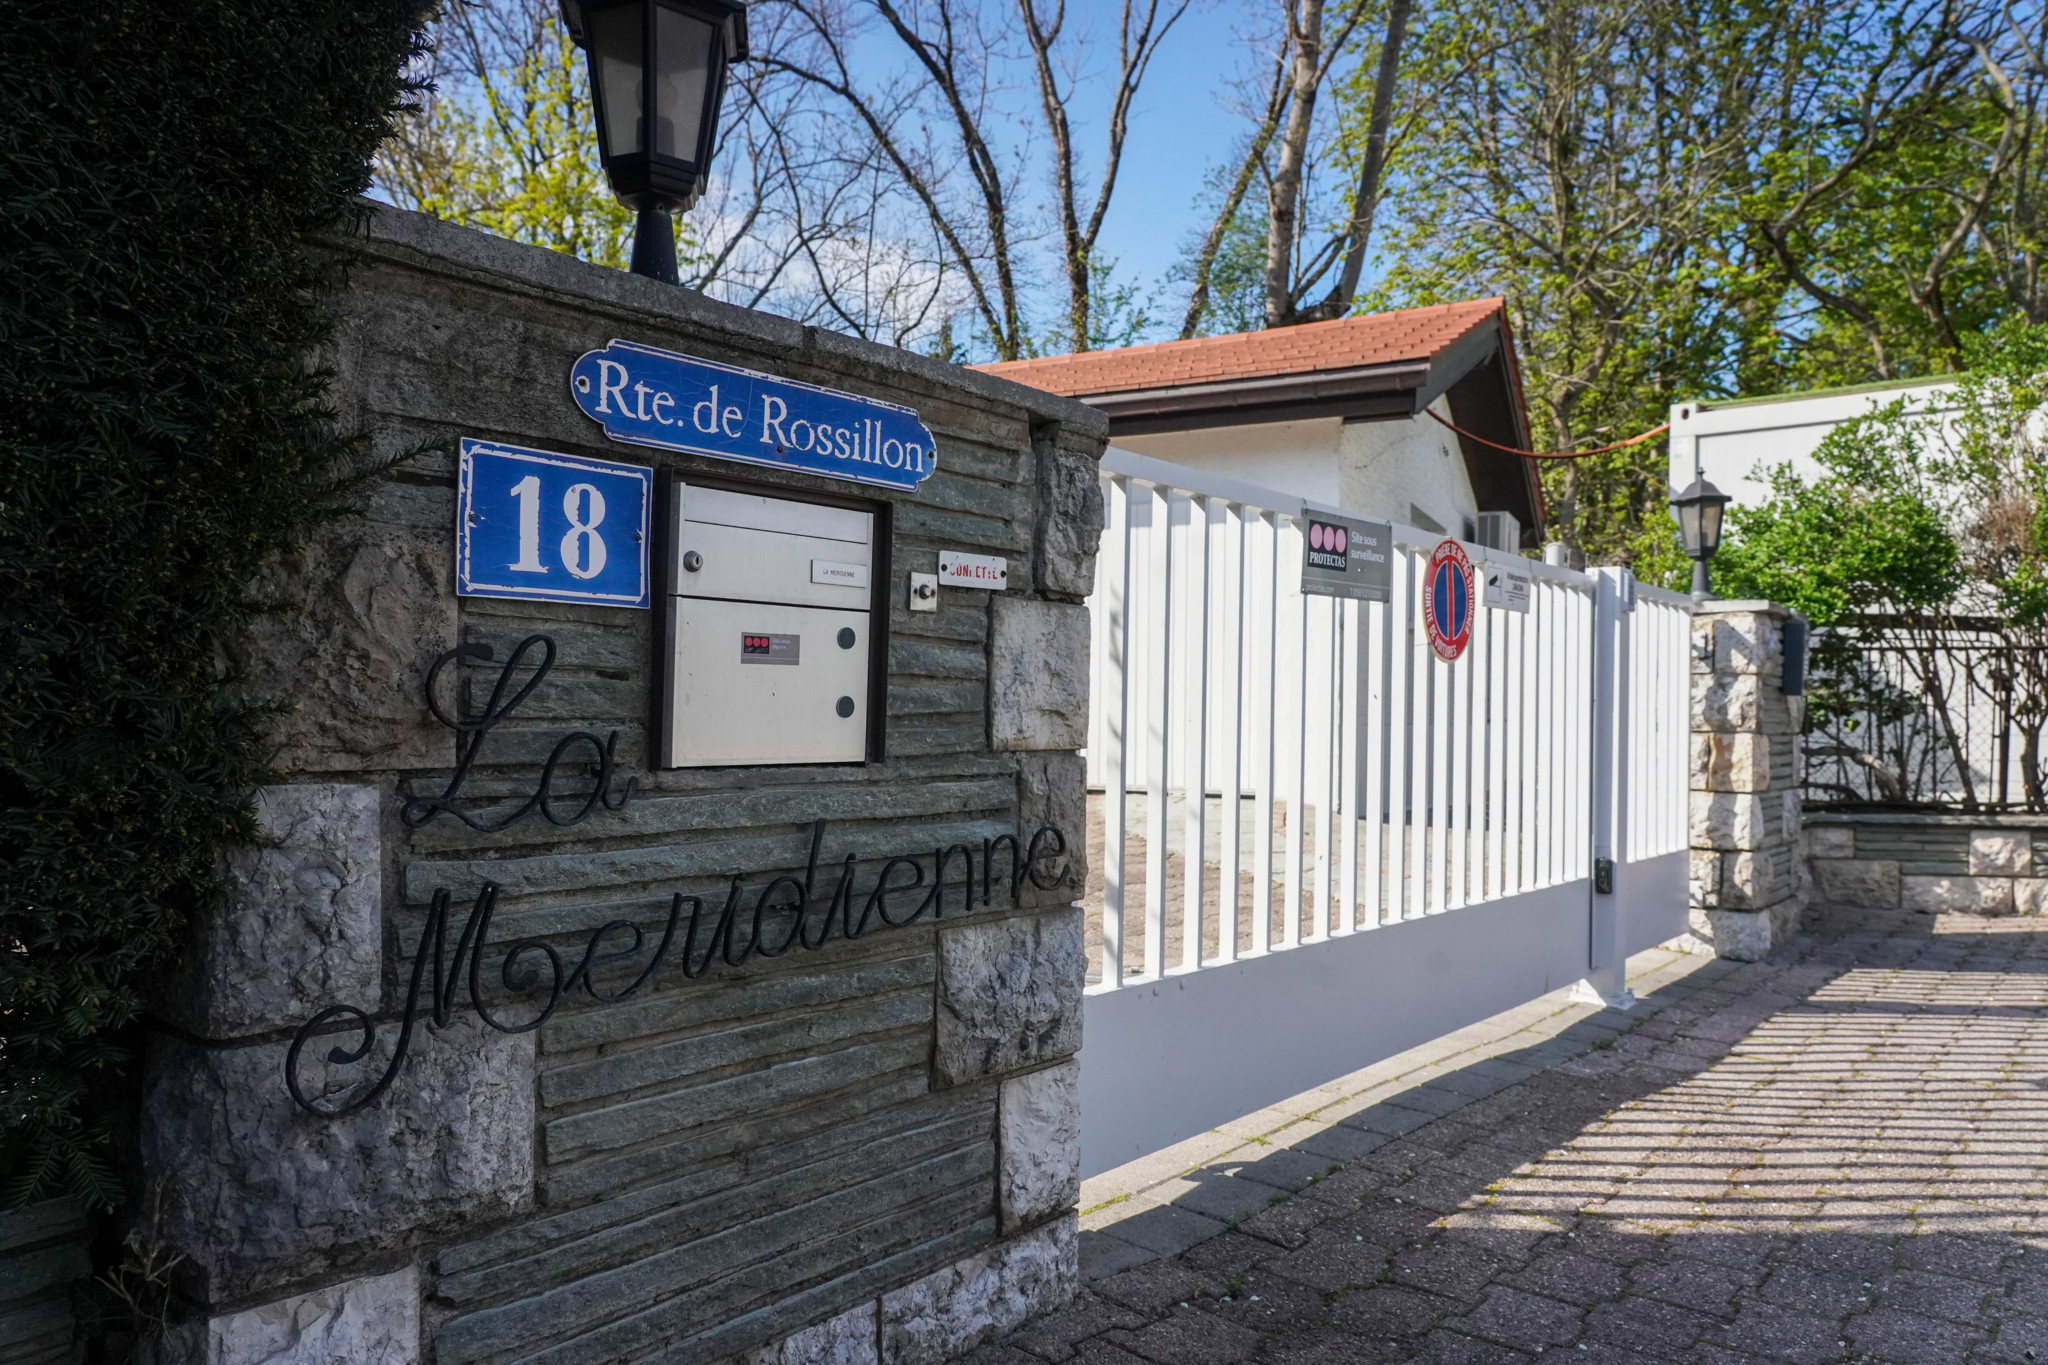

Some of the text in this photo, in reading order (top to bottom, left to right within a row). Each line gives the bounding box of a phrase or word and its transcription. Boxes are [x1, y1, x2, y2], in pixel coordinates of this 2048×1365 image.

[594, 358, 924, 474] Rte. de Rossillon
[506, 475, 608, 580] 18
[1309, 551, 1346, 568] PROTECTAS
[1350, 549, 1385, 563] surveillance
[1351, 531, 1378, 547] Site sous
[1462, 558, 1471, 577] PAS
[1425, 585, 1457, 658] SORTIE DE VOITURES
[1464, 576, 1474, 635] STATIONNER
[400, 634, 638, 833] La
[285, 819, 1069, 1118] Meridienne
